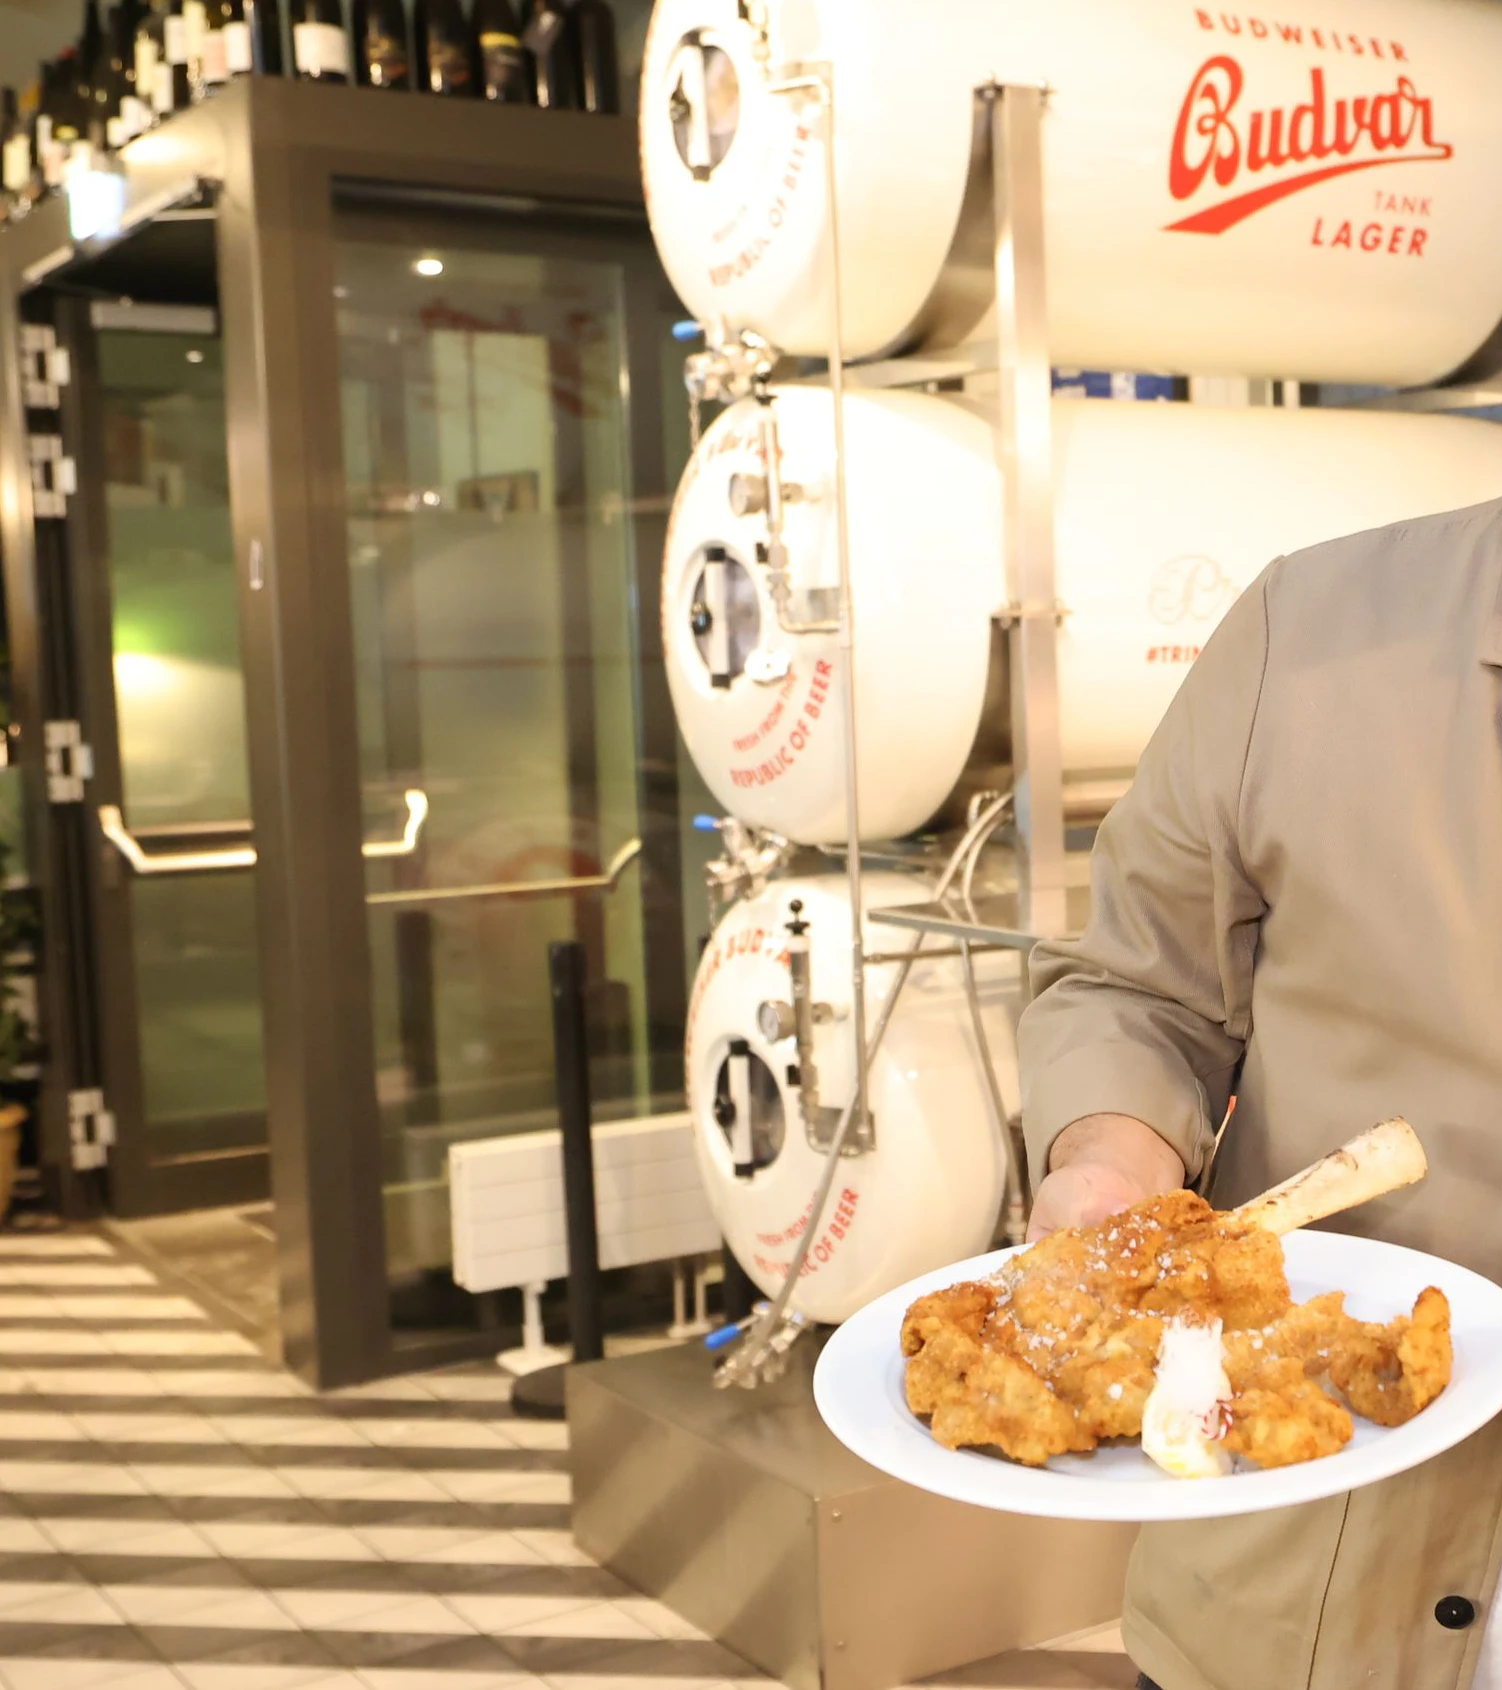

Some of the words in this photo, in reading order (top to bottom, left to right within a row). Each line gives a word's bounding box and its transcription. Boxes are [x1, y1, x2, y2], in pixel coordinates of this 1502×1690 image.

[1194, 7, 1409, 62] BUDWEISER
[1166, 53, 1454, 212] Budvar
[1375, 190, 1433, 216] TANK
[1310, 216, 1429, 257] LAGER
[790, 719, 812, 751] OF
[804, 659, 833, 720] BEER
[829, 1187, 860, 1241] BEER
